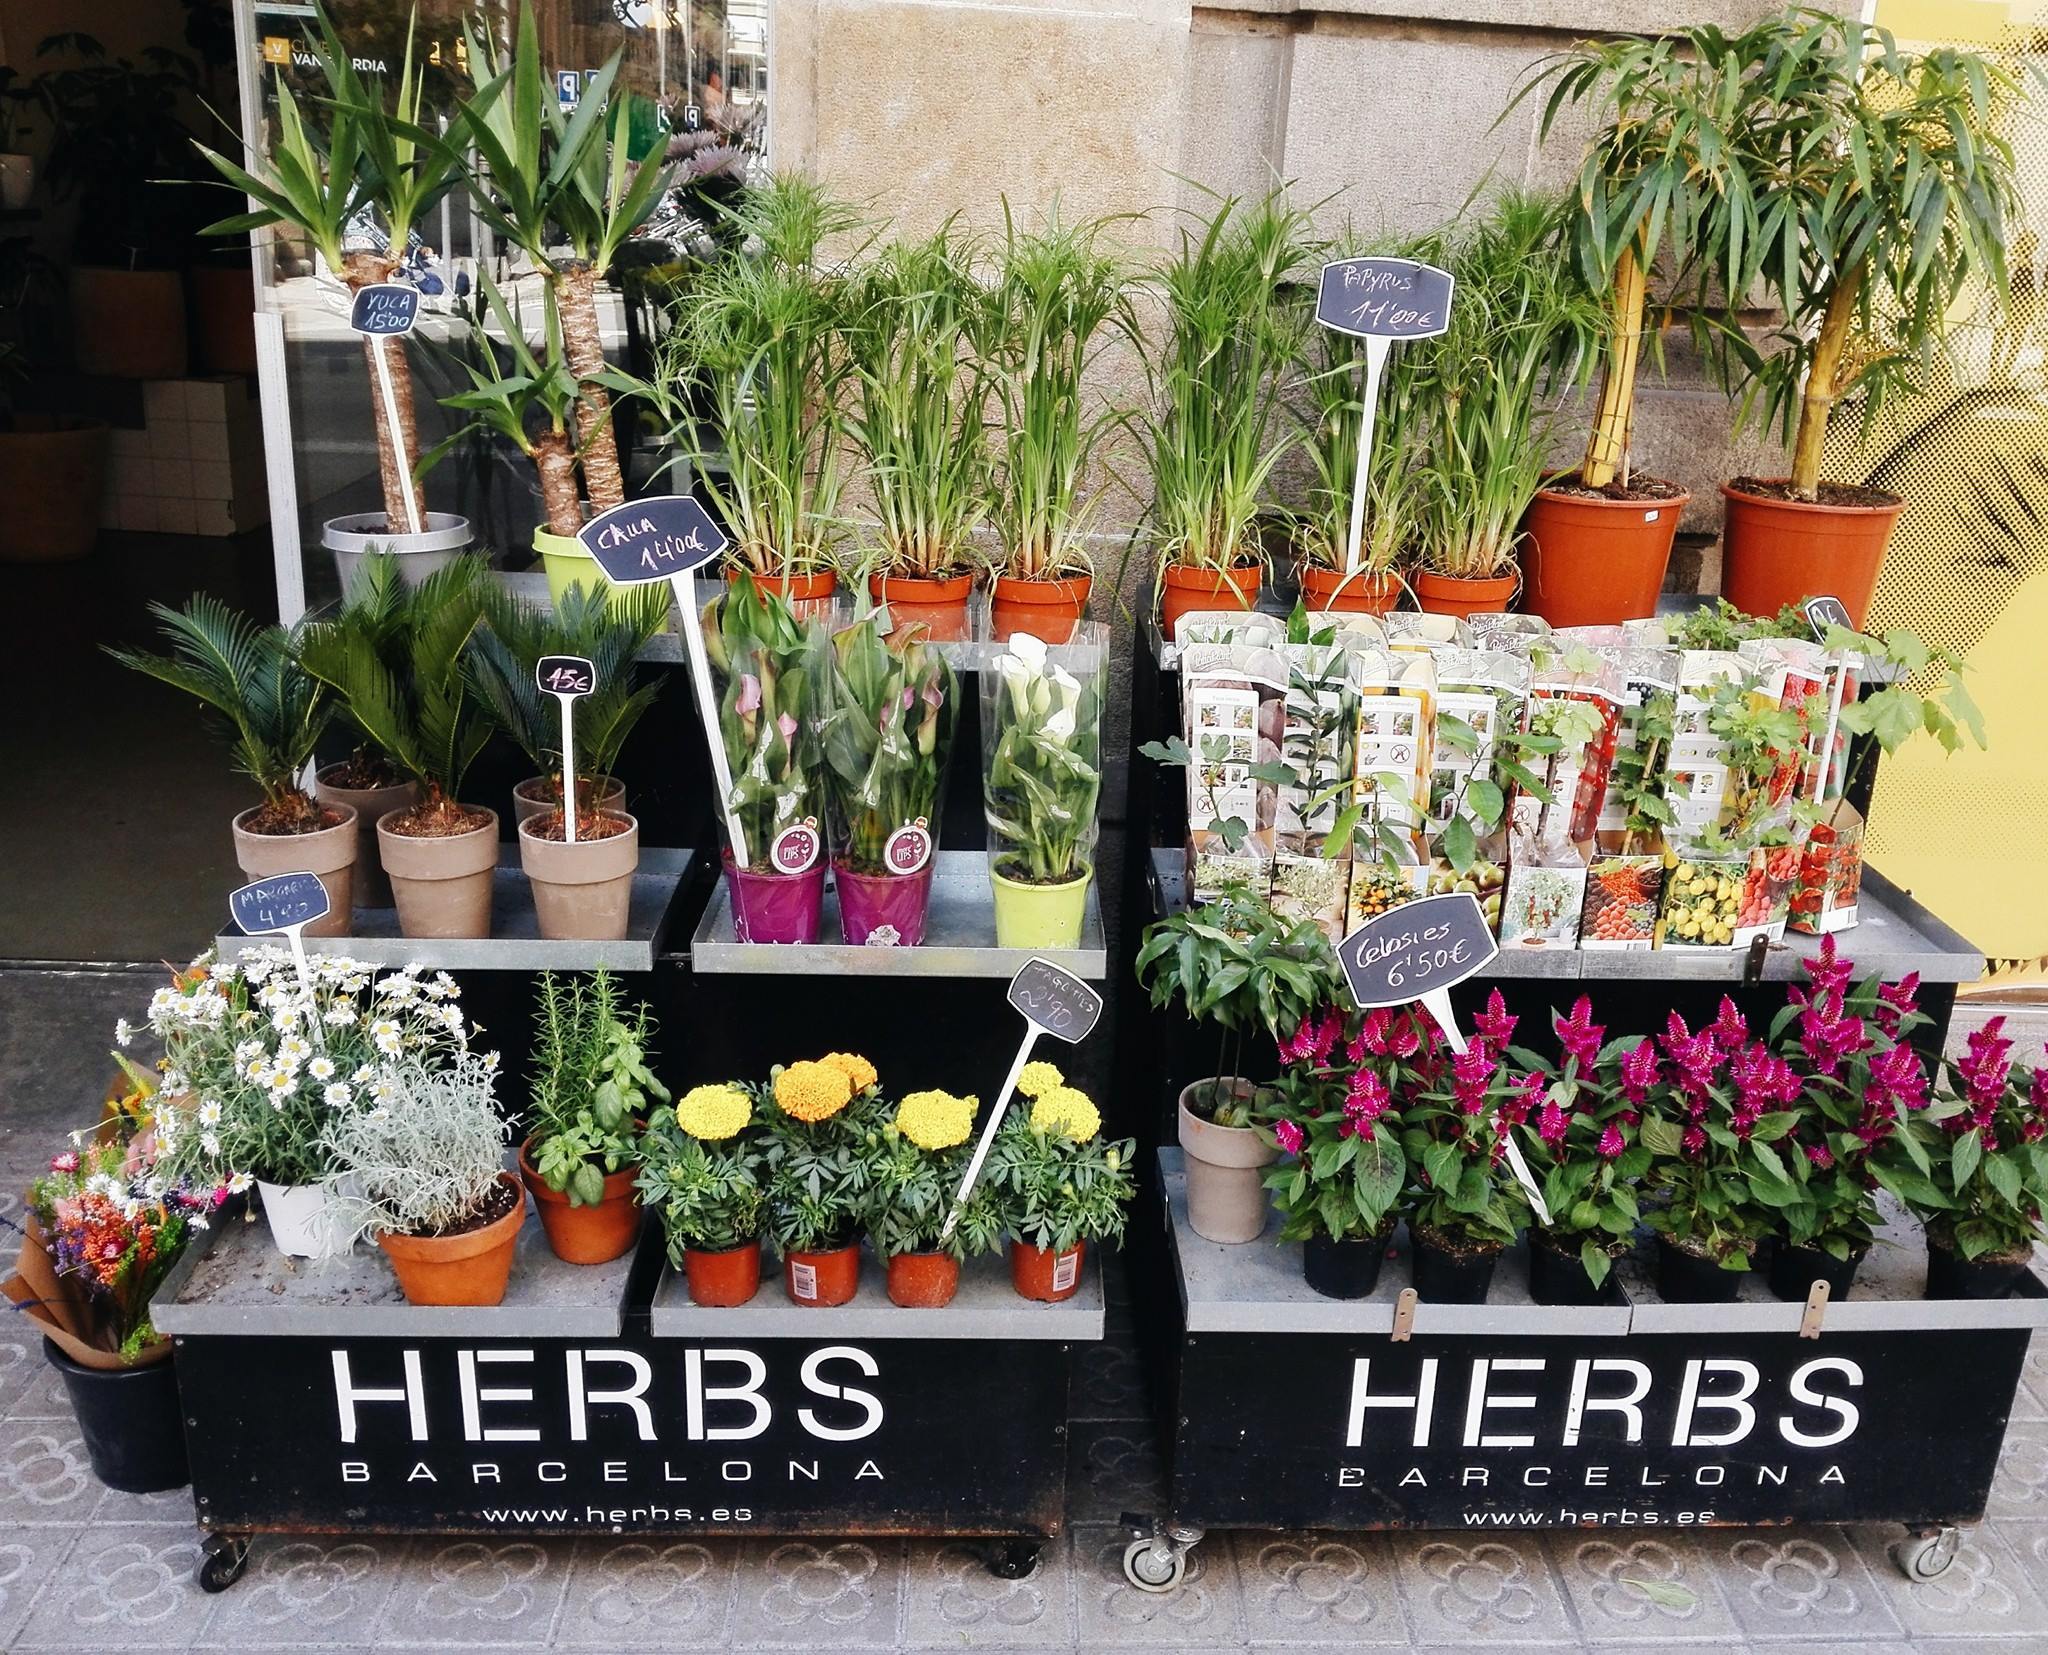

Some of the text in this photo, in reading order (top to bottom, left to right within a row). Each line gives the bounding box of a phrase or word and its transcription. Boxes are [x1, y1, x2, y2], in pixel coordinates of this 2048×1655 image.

[292, 53, 387, 72] VANRDIA
[1343, 265, 1412, 292] PAPYRUS
[367, 293, 411, 311] YUCA
[1356, 921, 1452, 968] Celosies
[332, 1347, 884, 1443] HERBS
[1346, 1358, 1864, 1447] HERBS
[341, 1460, 884, 1483] BARCELONA
[1338, 1465, 1845, 1487] BARCELONA
[482, 1505, 752, 1523] www.herbs.es
[1463, 1508, 1716, 1525] www.herbs.es
